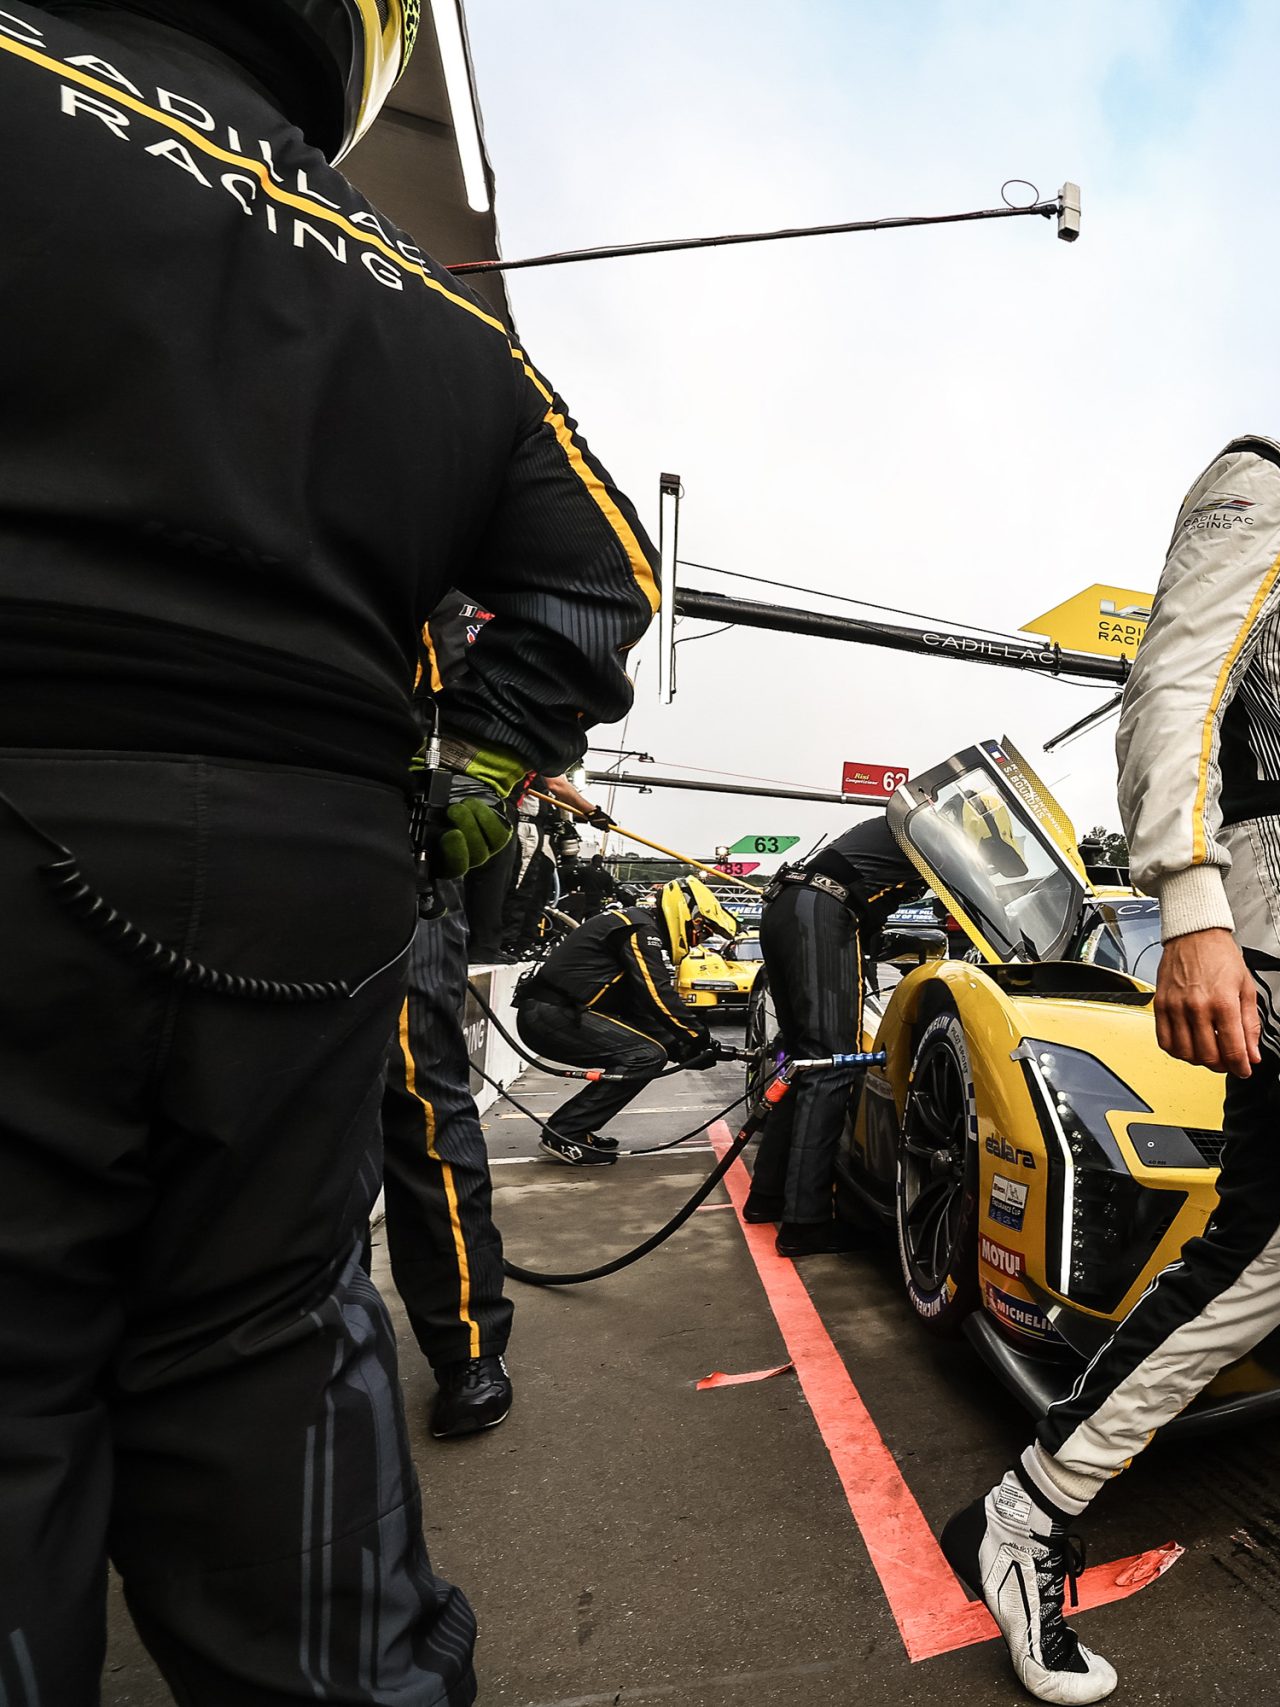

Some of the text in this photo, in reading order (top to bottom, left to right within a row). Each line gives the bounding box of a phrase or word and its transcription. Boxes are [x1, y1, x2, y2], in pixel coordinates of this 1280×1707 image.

[0, 10, 431, 273] CADILLAC
[61, 85, 403, 291] RACING
[1183, 513, 1255, 528] CADILLAC
[1187, 521, 1232, 532] ACING
[922, 633, 1054, 664] CADILLAC
[883, 771, 907, 792] 62
[1011, 775, 1046, 820] BOURDAIS
[755, 836, 779, 853] 63
[985, 1133, 1036, 1169] dallara
